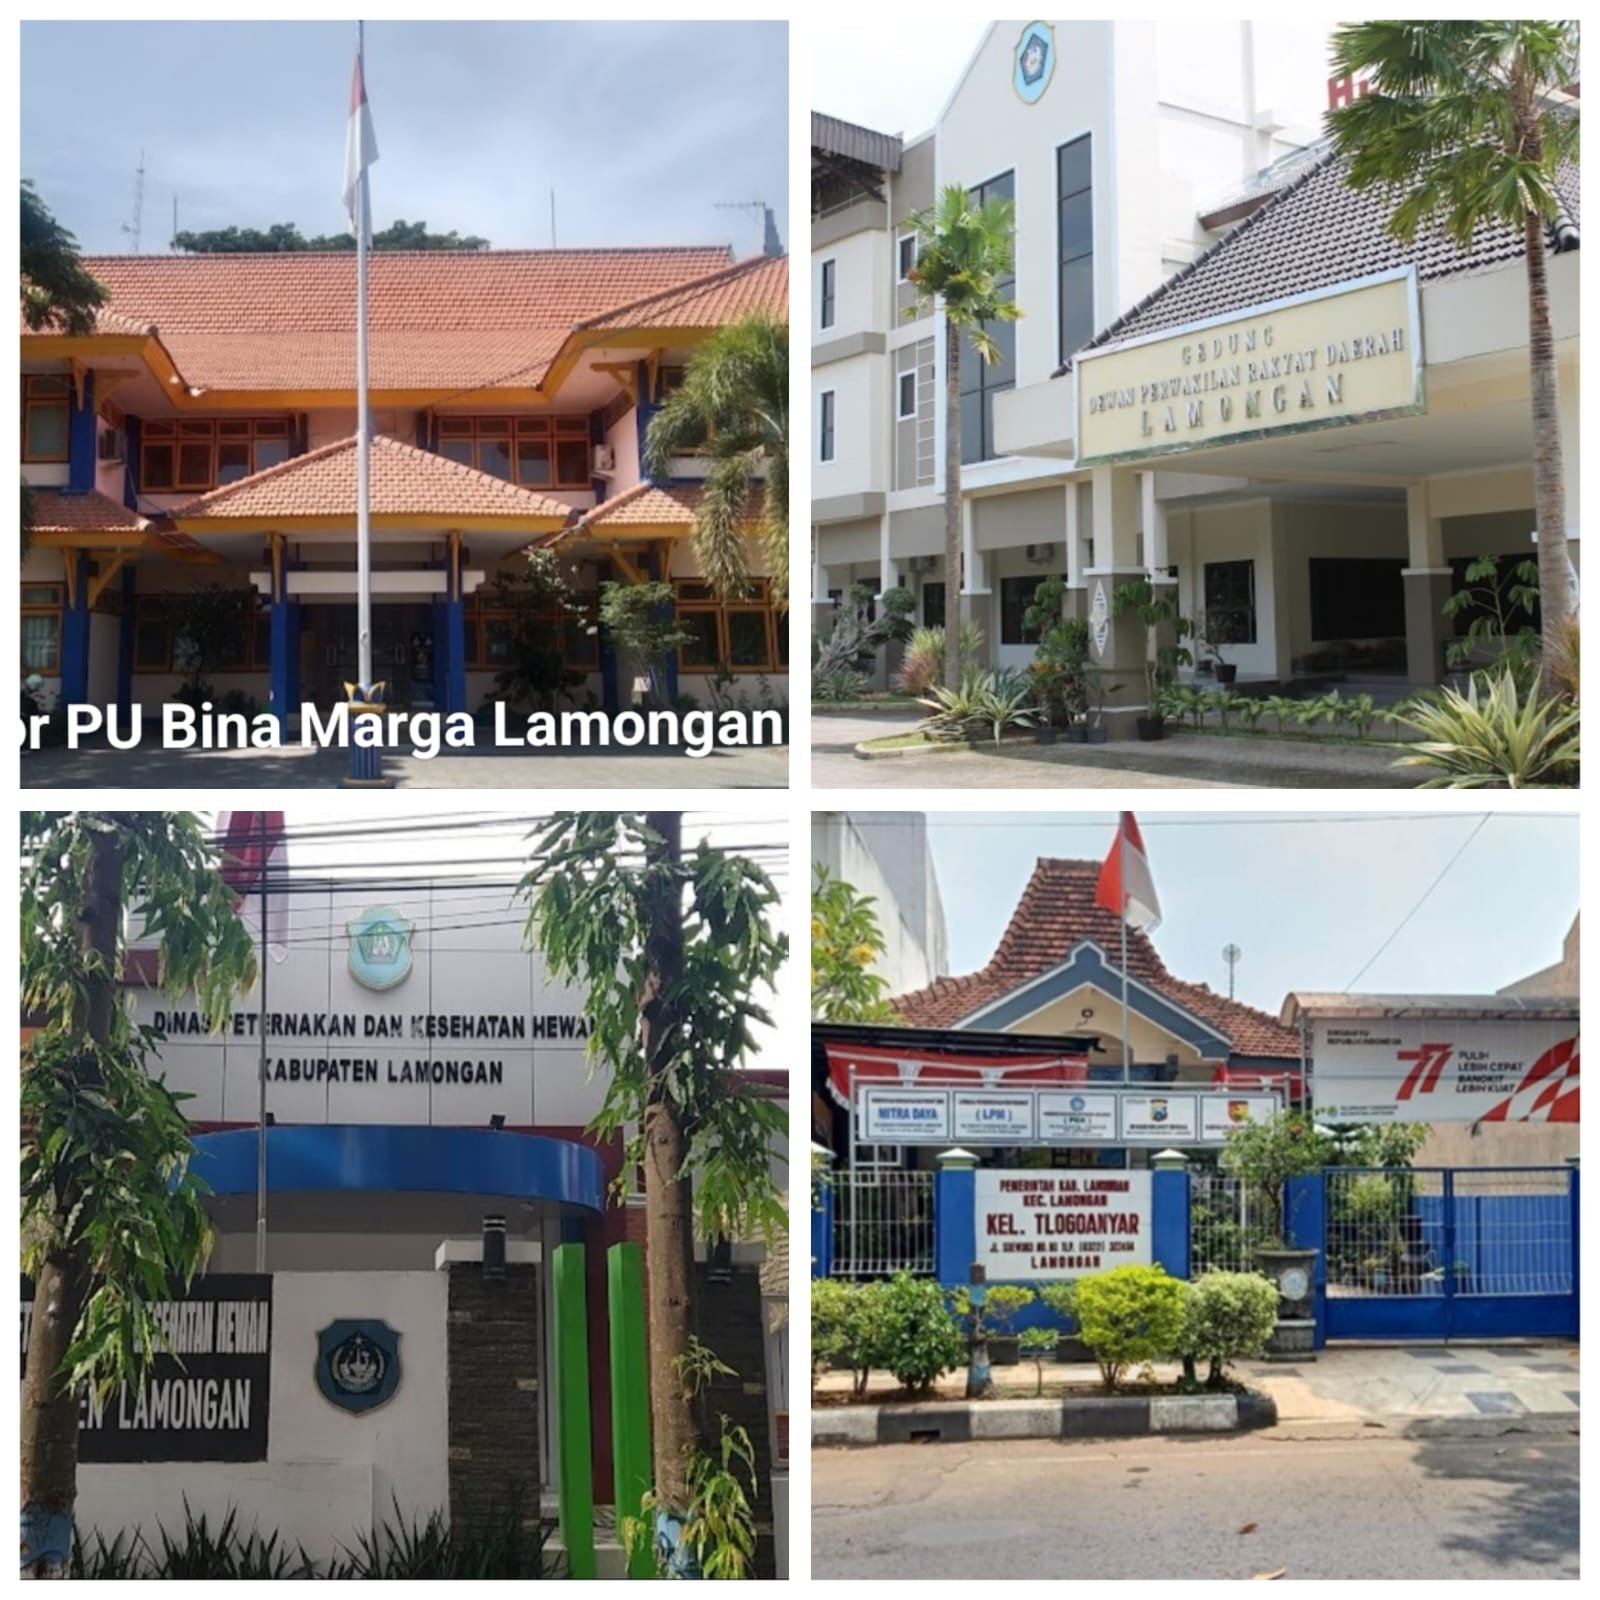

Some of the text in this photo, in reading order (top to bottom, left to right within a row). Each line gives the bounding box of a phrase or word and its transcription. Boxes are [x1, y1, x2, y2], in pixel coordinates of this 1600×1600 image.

[1181, 325, 1275, 365] GEDUNG
[1088, 327, 1405, 415] DEWAN PERWAKILAN RAKYAT DAERAH
[1141, 372, 1344, 437] LAMONGAN
[364, 1014, 402, 1038] DAN
[411, 1014, 526, 1039] KESEHATAN
[388, 1060, 503, 1084] LAMONGAN
[1396, 1043, 1454, 1101] 77
[1457, 1061, 1523, 1072] LEBIH CEPAT
[912, 1107, 939, 1120] DAYA
[1023, 1194, 1107, 1207] KEC. LAMONGAN
[986, 1212, 1140, 1235] KEL. TLOGOANYAR
[1030, 1255, 1100, 1270] LAMONGAN
[216, 1300, 268, 1353] HEWAN
[118, 1378, 251, 1429] LAMONGAN
